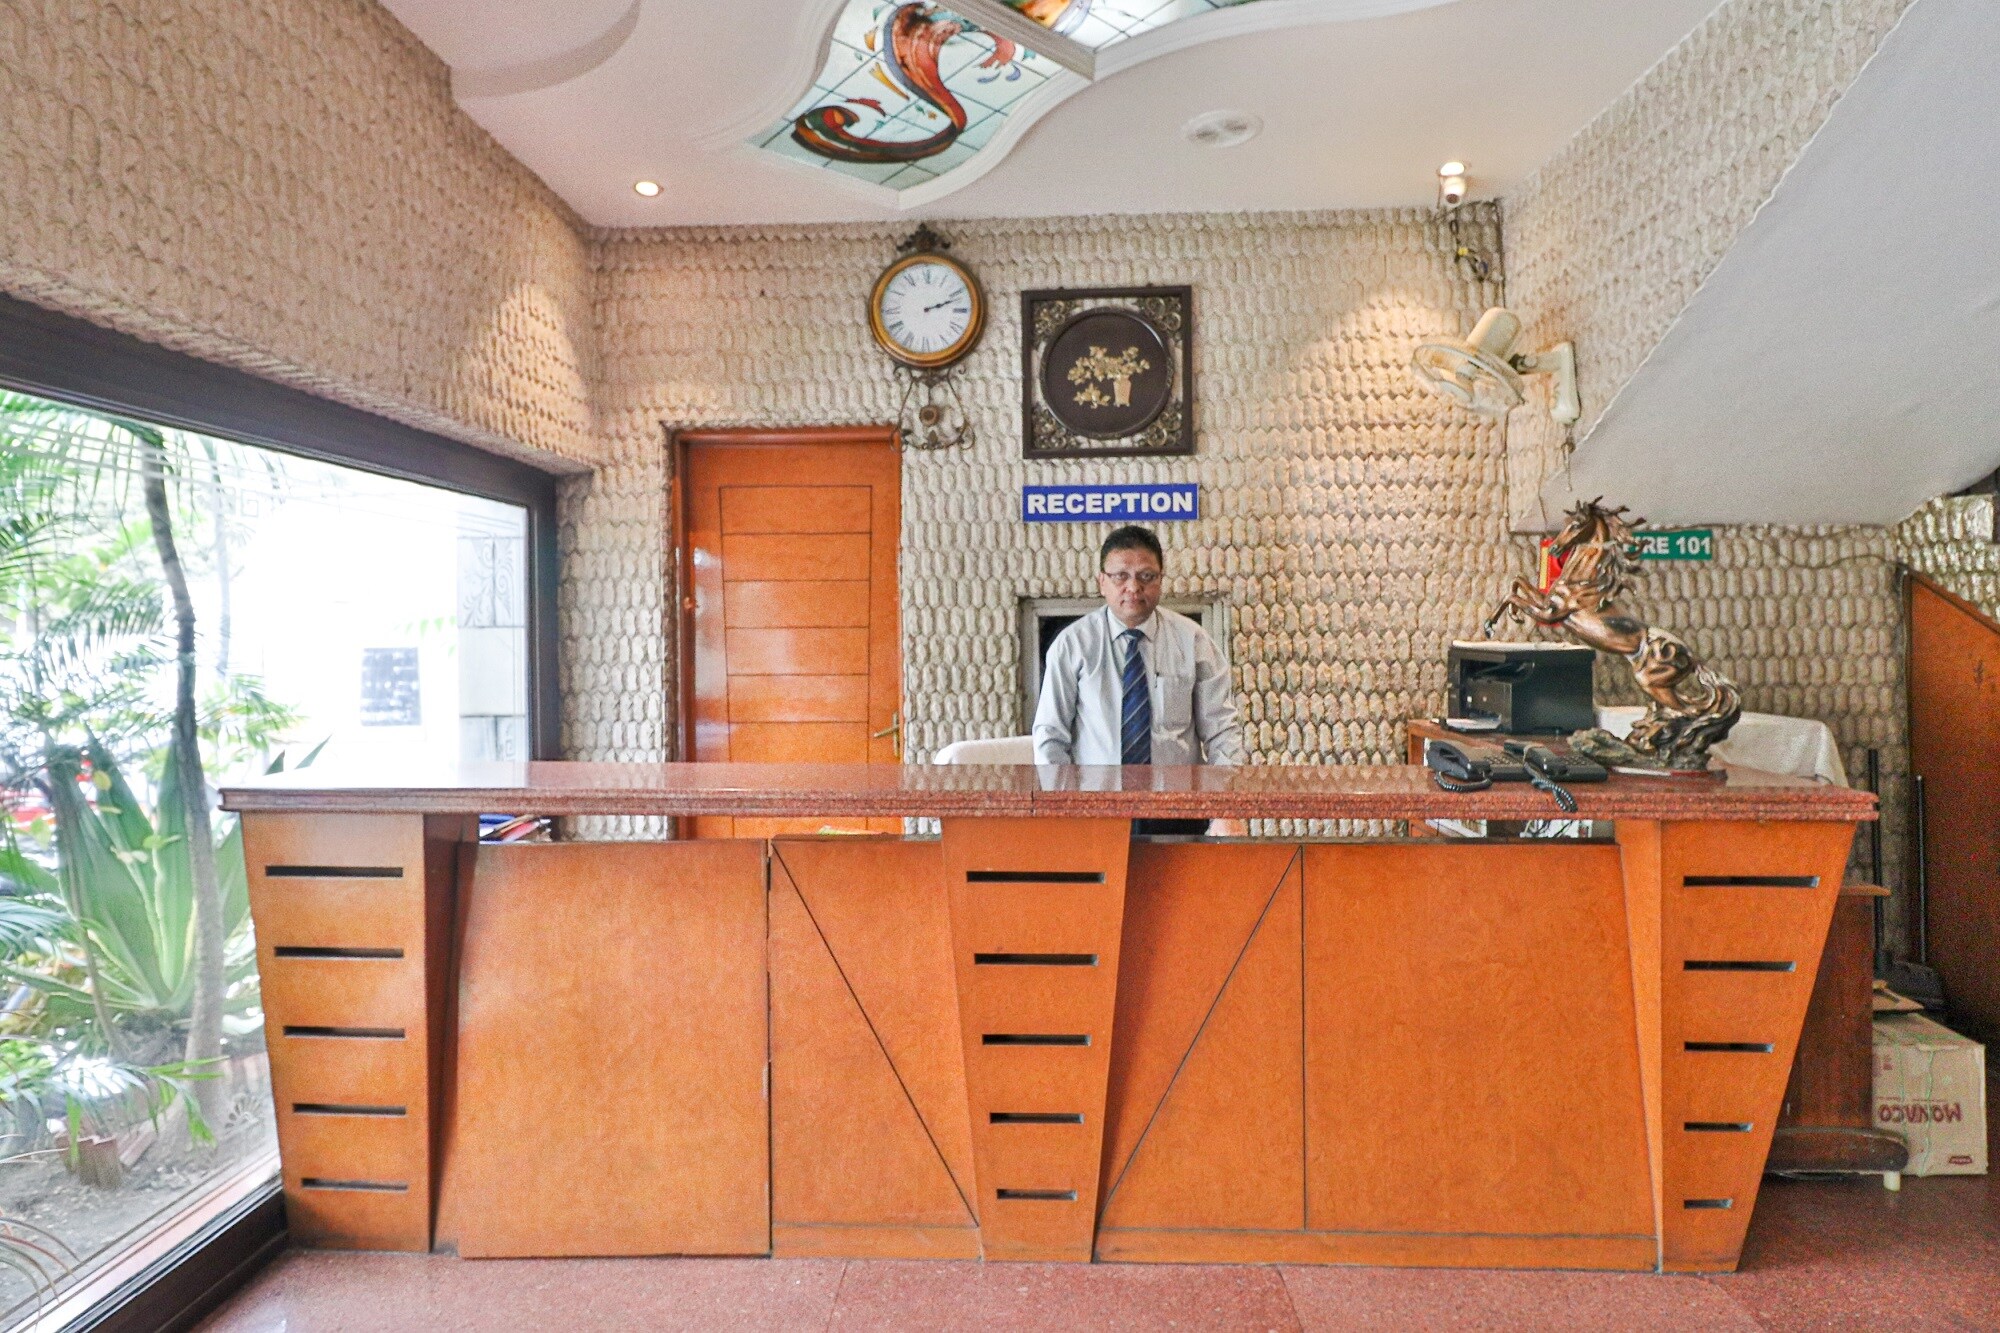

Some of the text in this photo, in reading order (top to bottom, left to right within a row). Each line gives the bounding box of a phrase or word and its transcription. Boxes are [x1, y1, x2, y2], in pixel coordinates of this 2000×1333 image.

[1027, 491, 1193, 515] RECEPTION
[1675, 535, 1711, 555] 101
[1878, 1102, 1963, 1123] MONACO
